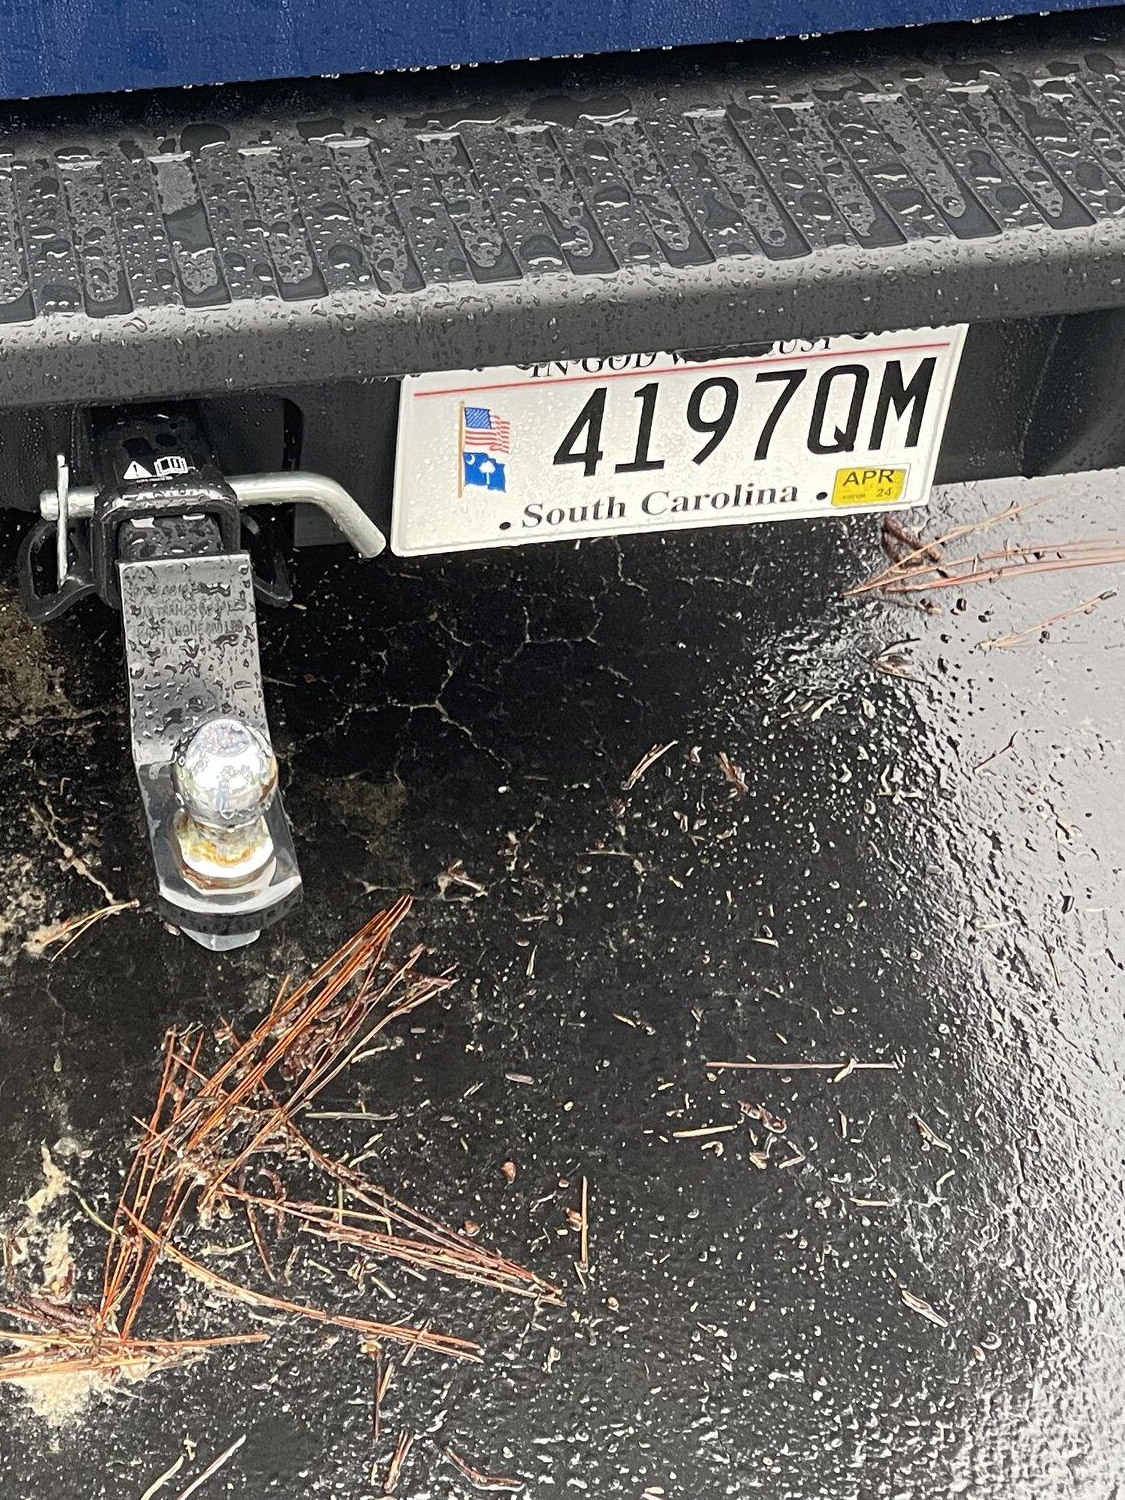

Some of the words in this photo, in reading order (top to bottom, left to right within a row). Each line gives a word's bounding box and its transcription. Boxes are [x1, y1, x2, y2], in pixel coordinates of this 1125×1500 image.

[581, 352, 657, 373] GOD
[552, 357, 938, 478] 4197QM
[843, 468, 894, 486] APR
[876, 487, 892, 498] 24
[522, 496, 626, 529] South
[641, 482, 799, 516] Carolina
